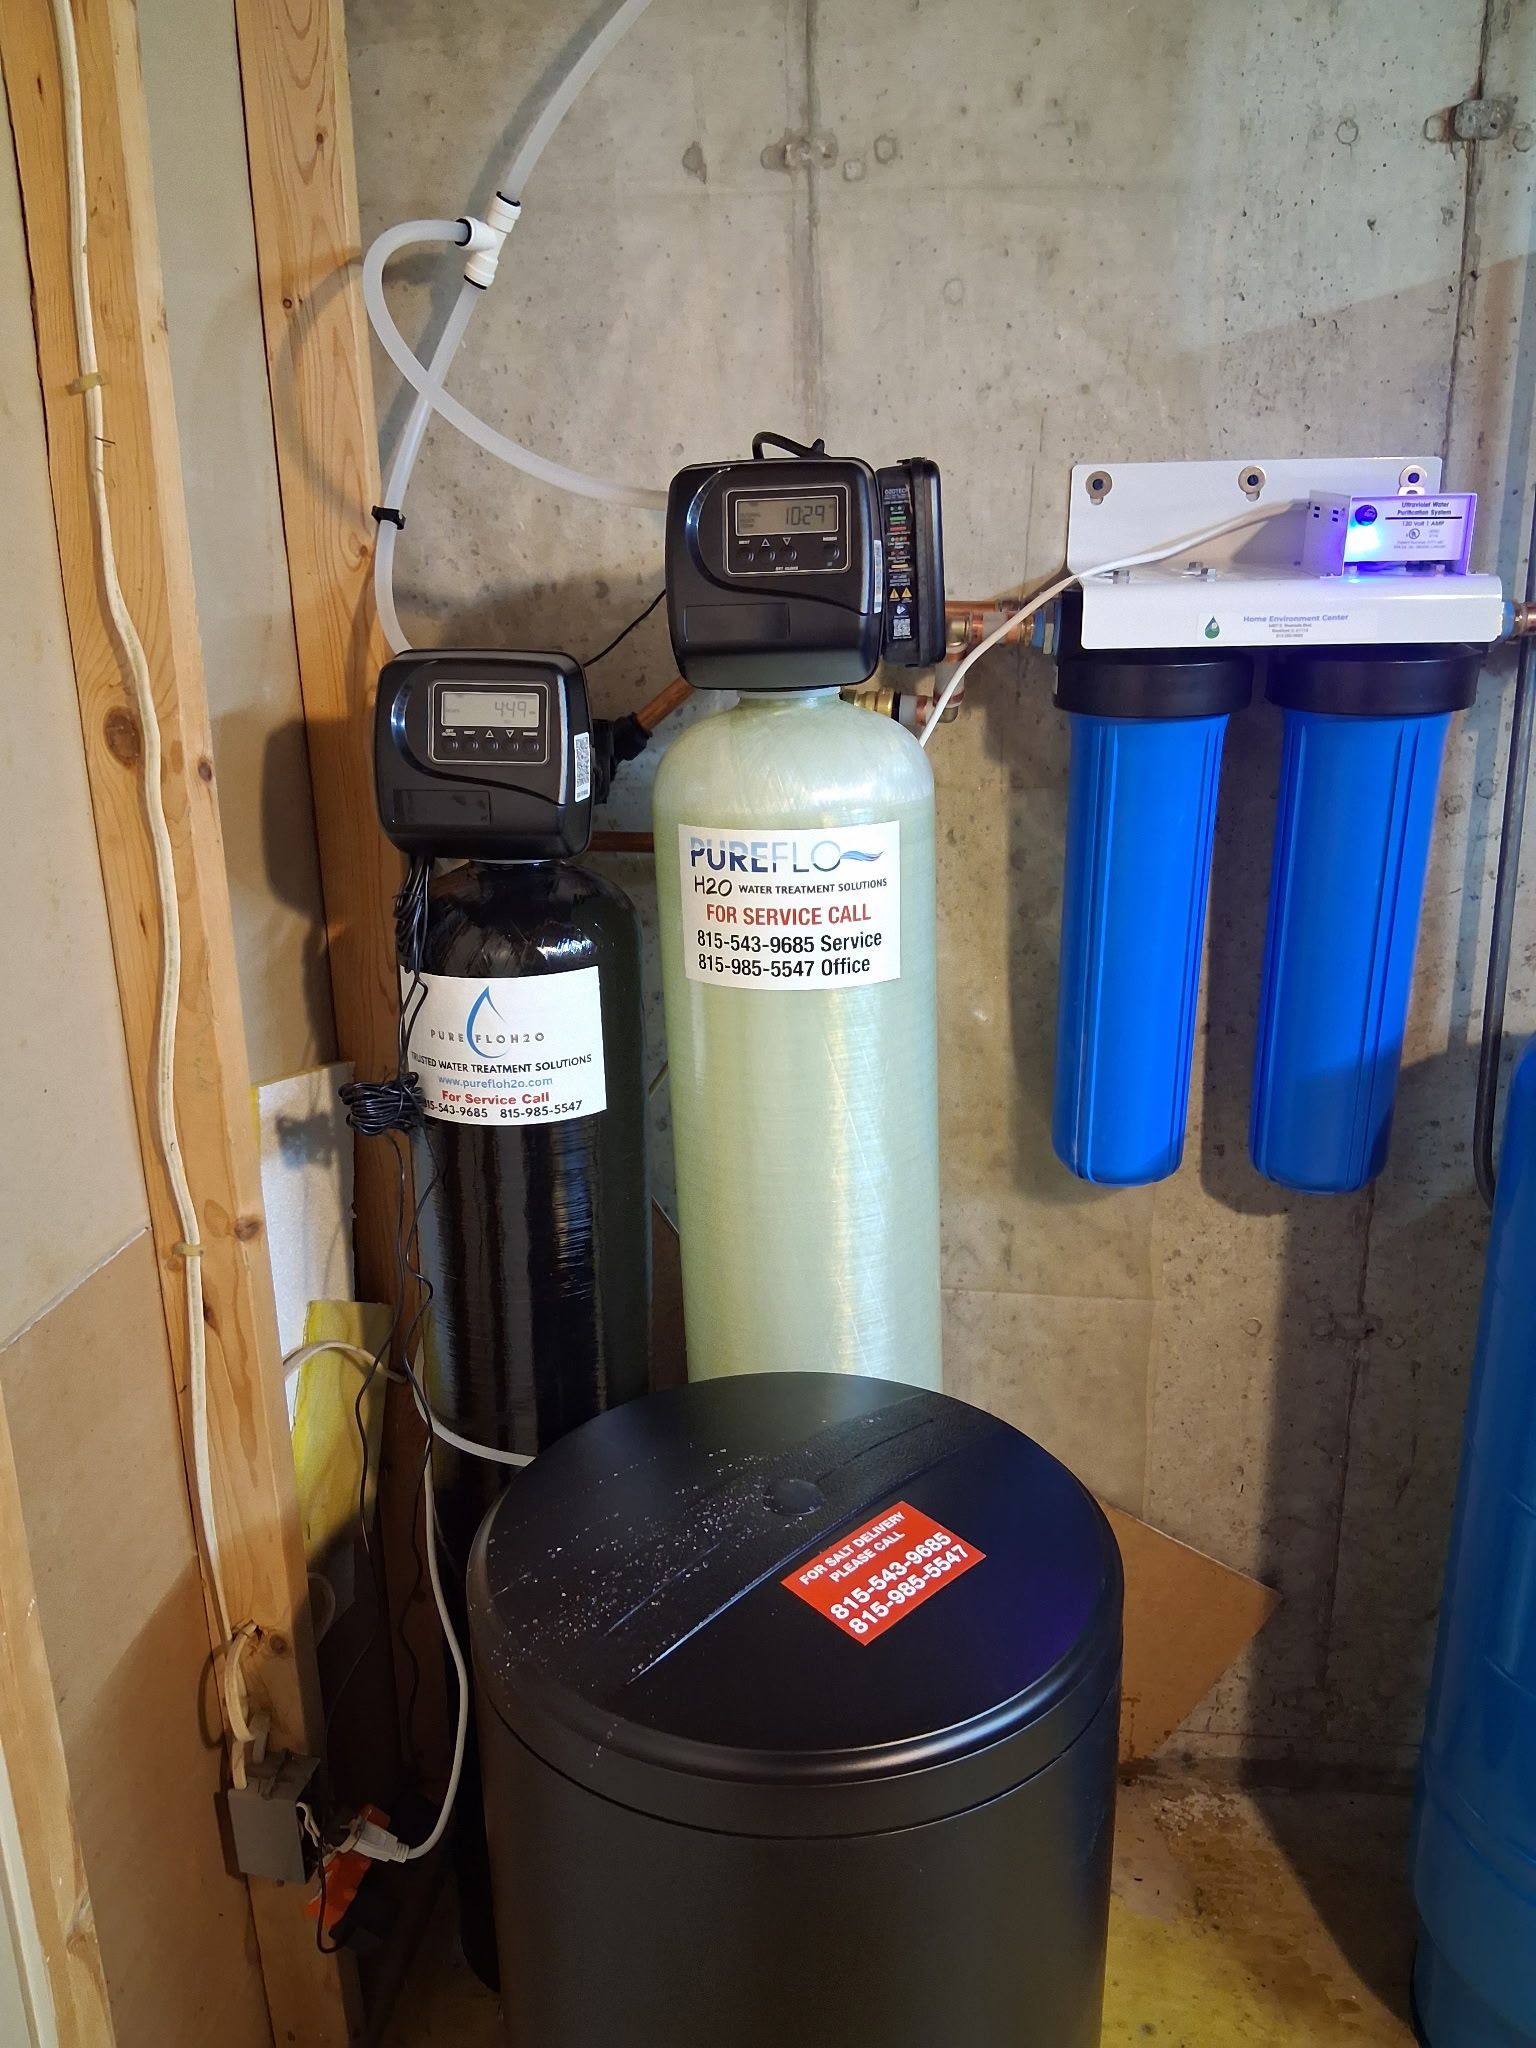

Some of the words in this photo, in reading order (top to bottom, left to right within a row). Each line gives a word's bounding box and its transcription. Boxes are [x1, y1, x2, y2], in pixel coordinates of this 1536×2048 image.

[1243, 615, 1267, 623] Home
[690, 837, 841, 873] PUREFLO
[694, 875, 733, 897] H2O
[738, 884, 773, 895] WATER
[776, 884, 836, 895] TREATMENT
[837, 878, 888, 892] SOLUTIONS
[706, 904, 738, 924] FOR
[743, 907, 823, 926] SERVICE
[828, 903, 872, 924] CALL
[697, 930, 815, 953] 815-543-9685
[820, 931, 882, 952] Service
[698, 953, 815, 977] 815-985-5547
[821, 957, 871, 976] Office
[430, 1029, 465, 1043] PURE
[438, 1060, 469, 1073] WATER
[471, 1063, 532, 1074] TREATMENT
[535, 1053, 592, 1071] SOLUTIONS
[438, 1075, 553, 1090] www.purefloh2o.com
[441, 1090, 461, 1102] For
[464, 1093, 517, 1105] Service
[521, 1092, 550, 1104] Call
[499, 1100, 583, 1119] 815-985-5547
[798, 1563, 828, 1586] FOR
[825, 1545, 853, 1569] SALT
[852, 1511, 906, 1547] DELIVERY
[829, 1549, 877, 1582] PLEASE
[873, 1531, 906, 1552] CALL
[830, 1531, 953, 1620] 815-543-9685
[848, 1544, 969, 1635] 815-985-5547
